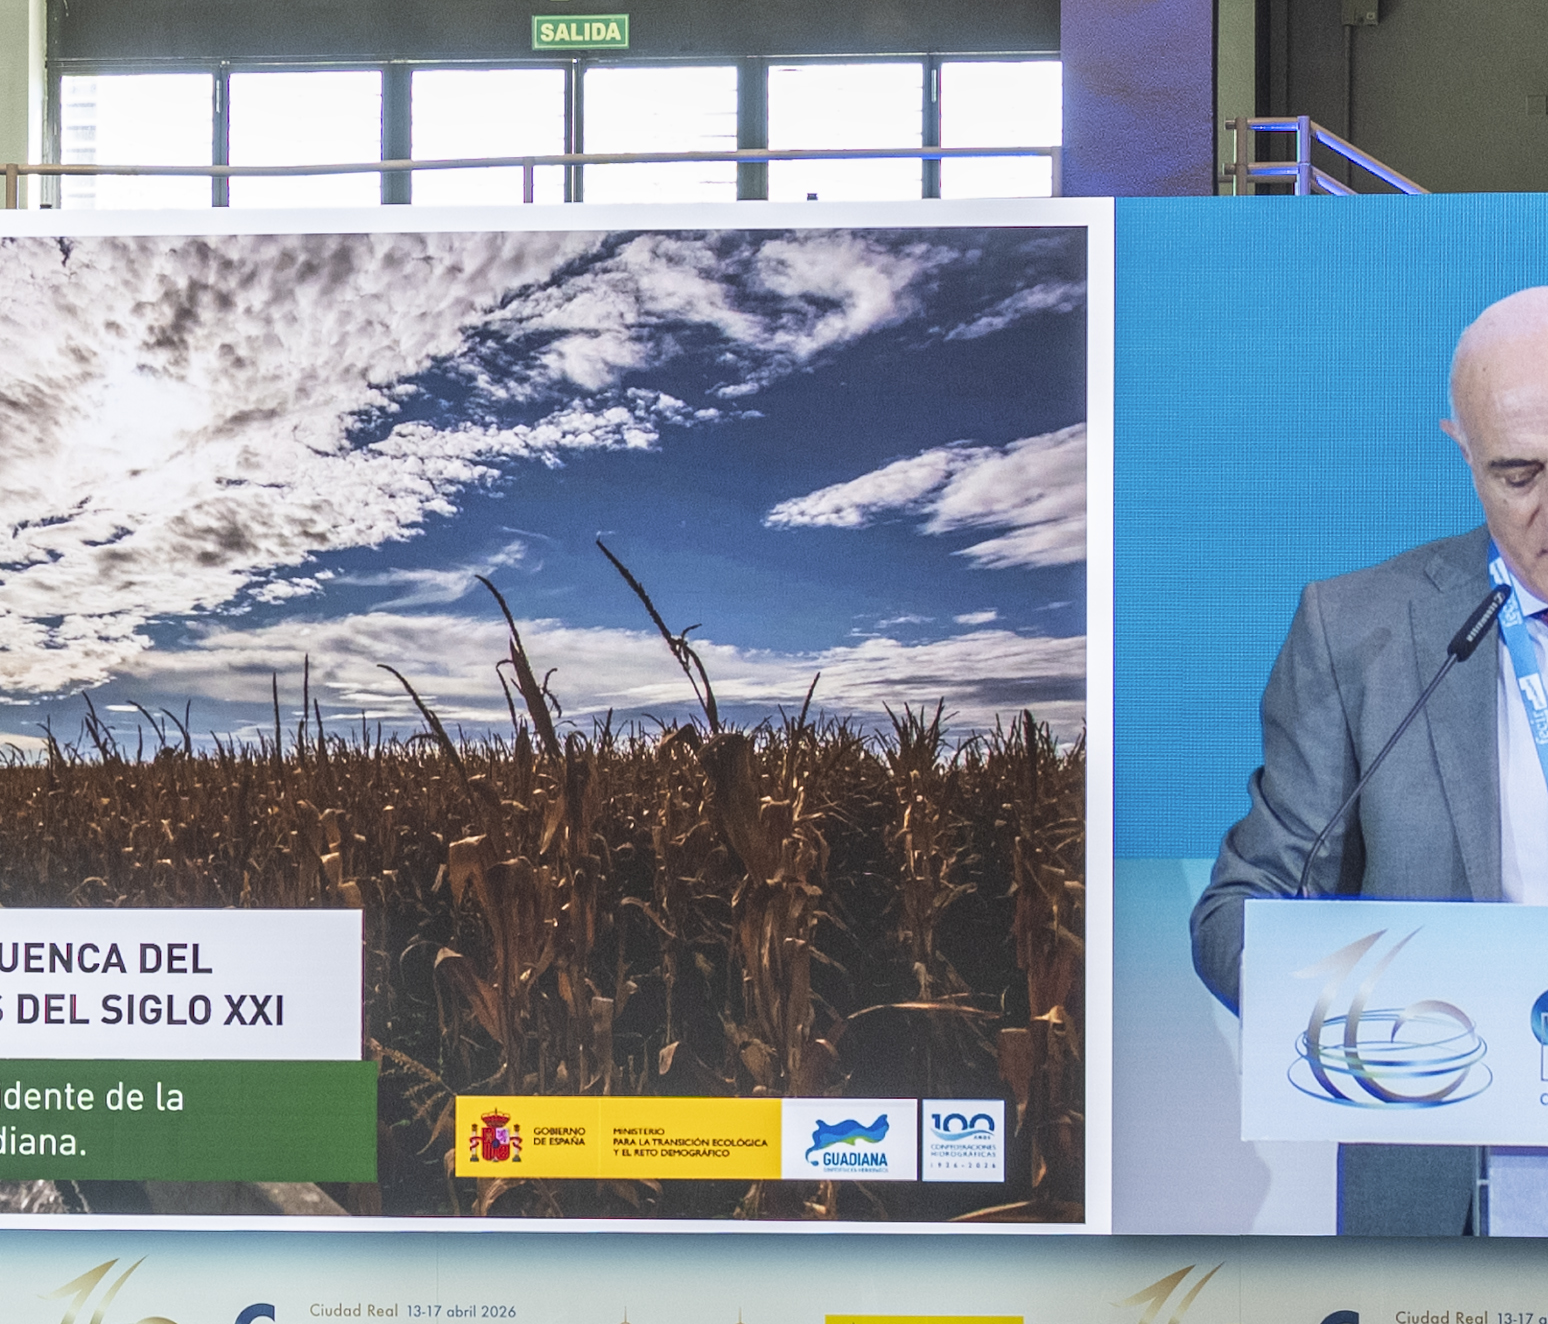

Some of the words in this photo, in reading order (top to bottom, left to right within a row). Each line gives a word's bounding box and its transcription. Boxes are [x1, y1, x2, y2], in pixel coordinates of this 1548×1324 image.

[540, 21, 621, 42] SALIDA
[140, 943, 212, 974] DEL
[18, 994, 89, 1024] DEL
[101, 994, 211, 1025] SIGLO
[224, 995, 283, 1025] XXI
[107, 1082, 143, 1110] de
[157, 1082, 182, 1110] la
[533, 1127, 586, 1135] GOBIERNO
[613, 1127, 665, 1135] MINISTERIO
[533, 1138, 547, 1146] DE
[549, 1136, 586, 1146] ESPAÑA
[613, 1138, 636, 1147] PARA
[639, 1139, 651, 1147] LA
[652, 1137, 710, 1147] TRANSICIÓN
[712, 1137, 768, 1147] ECOLÓGICA
[634, 1149, 658, 1157] RETO
[660, 1148, 730, 1157] DEMOGRÁFICO
[823, 1151, 888, 1167] GUADIANA
[310, 1303, 361, 1316] Ciudad
[368, 1304, 398, 1317] Real
[408, 1305, 442, 1317] 13-17
[447, 1305, 476, 1317] abril
[481, 1305, 516, 1318] 2026
[1396, 1311, 1449, 1324] Ciudad
[1456, 1311, 1488, 1324] Real
[1498, 1313, 1533, 1324] 13-17
